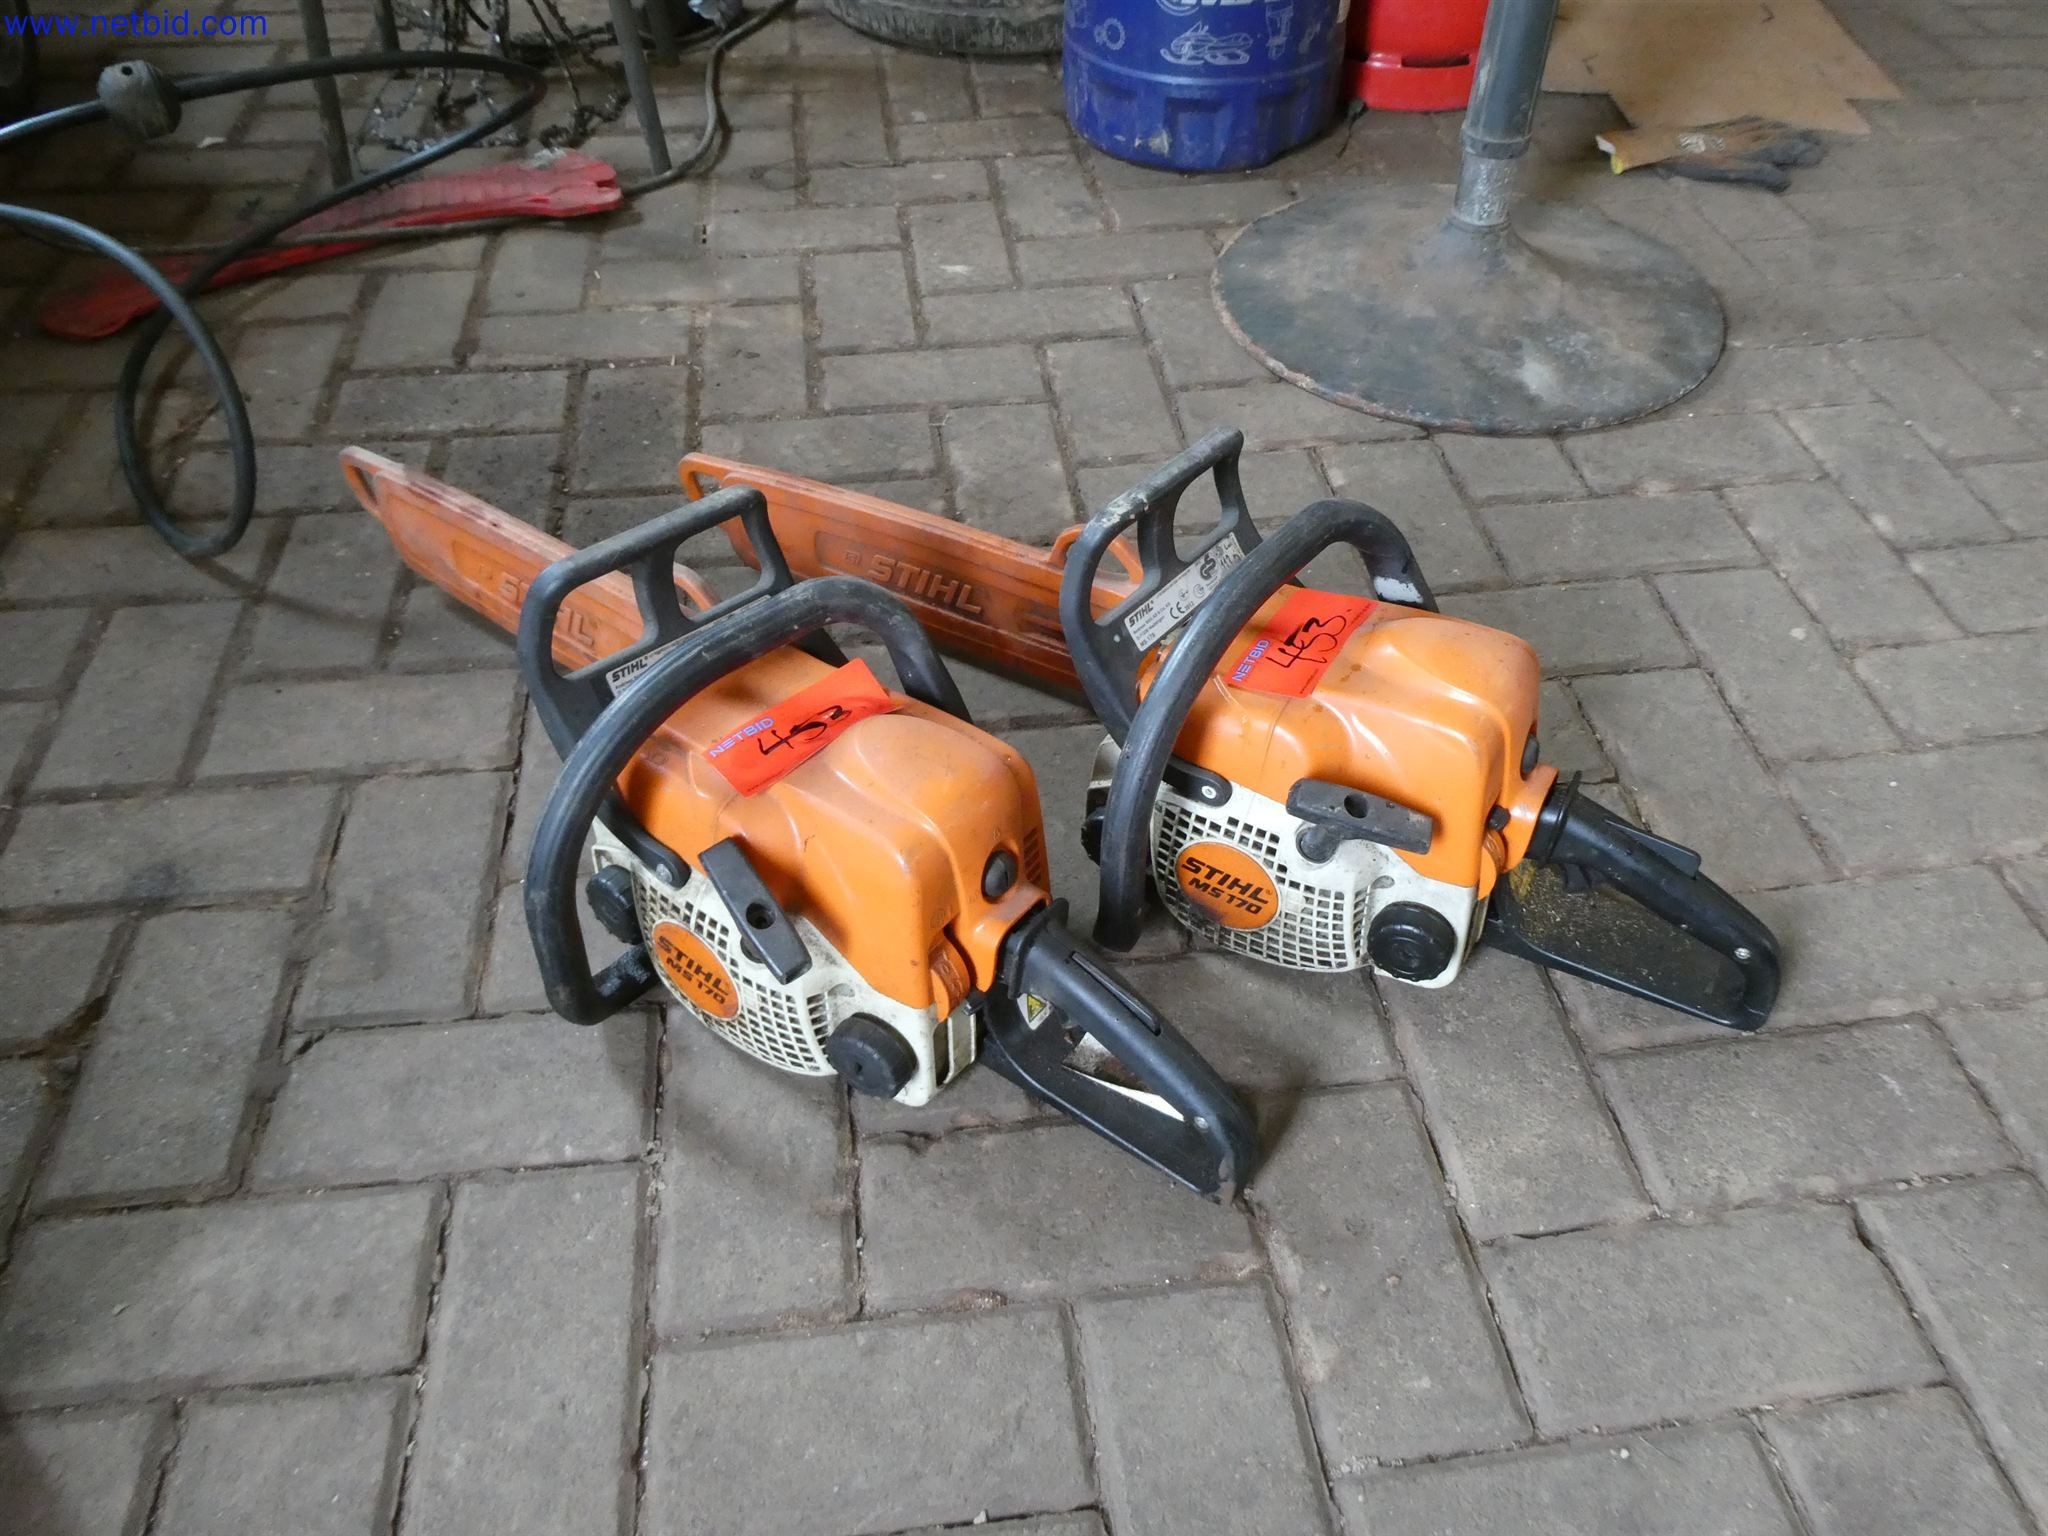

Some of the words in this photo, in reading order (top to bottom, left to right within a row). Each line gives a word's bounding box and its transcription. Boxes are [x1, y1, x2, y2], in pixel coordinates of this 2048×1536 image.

[868, 554, 982, 614] STIHL
[1129, 602, 1154, 627] STIHL
[612, 658, 648, 682] STIHL
[1231, 639, 1271, 682] NETBID
[709, 716, 775, 758] NETBID
[1181, 856, 1269, 905] STIHL
[1188, 877, 1224, 898] MS
[1226, 892, 1262, 915] 170
[657, 936, 729, 996] STIHL
[666, 957, 693, 981] MS
[695, 979, 726, 1005] 170
